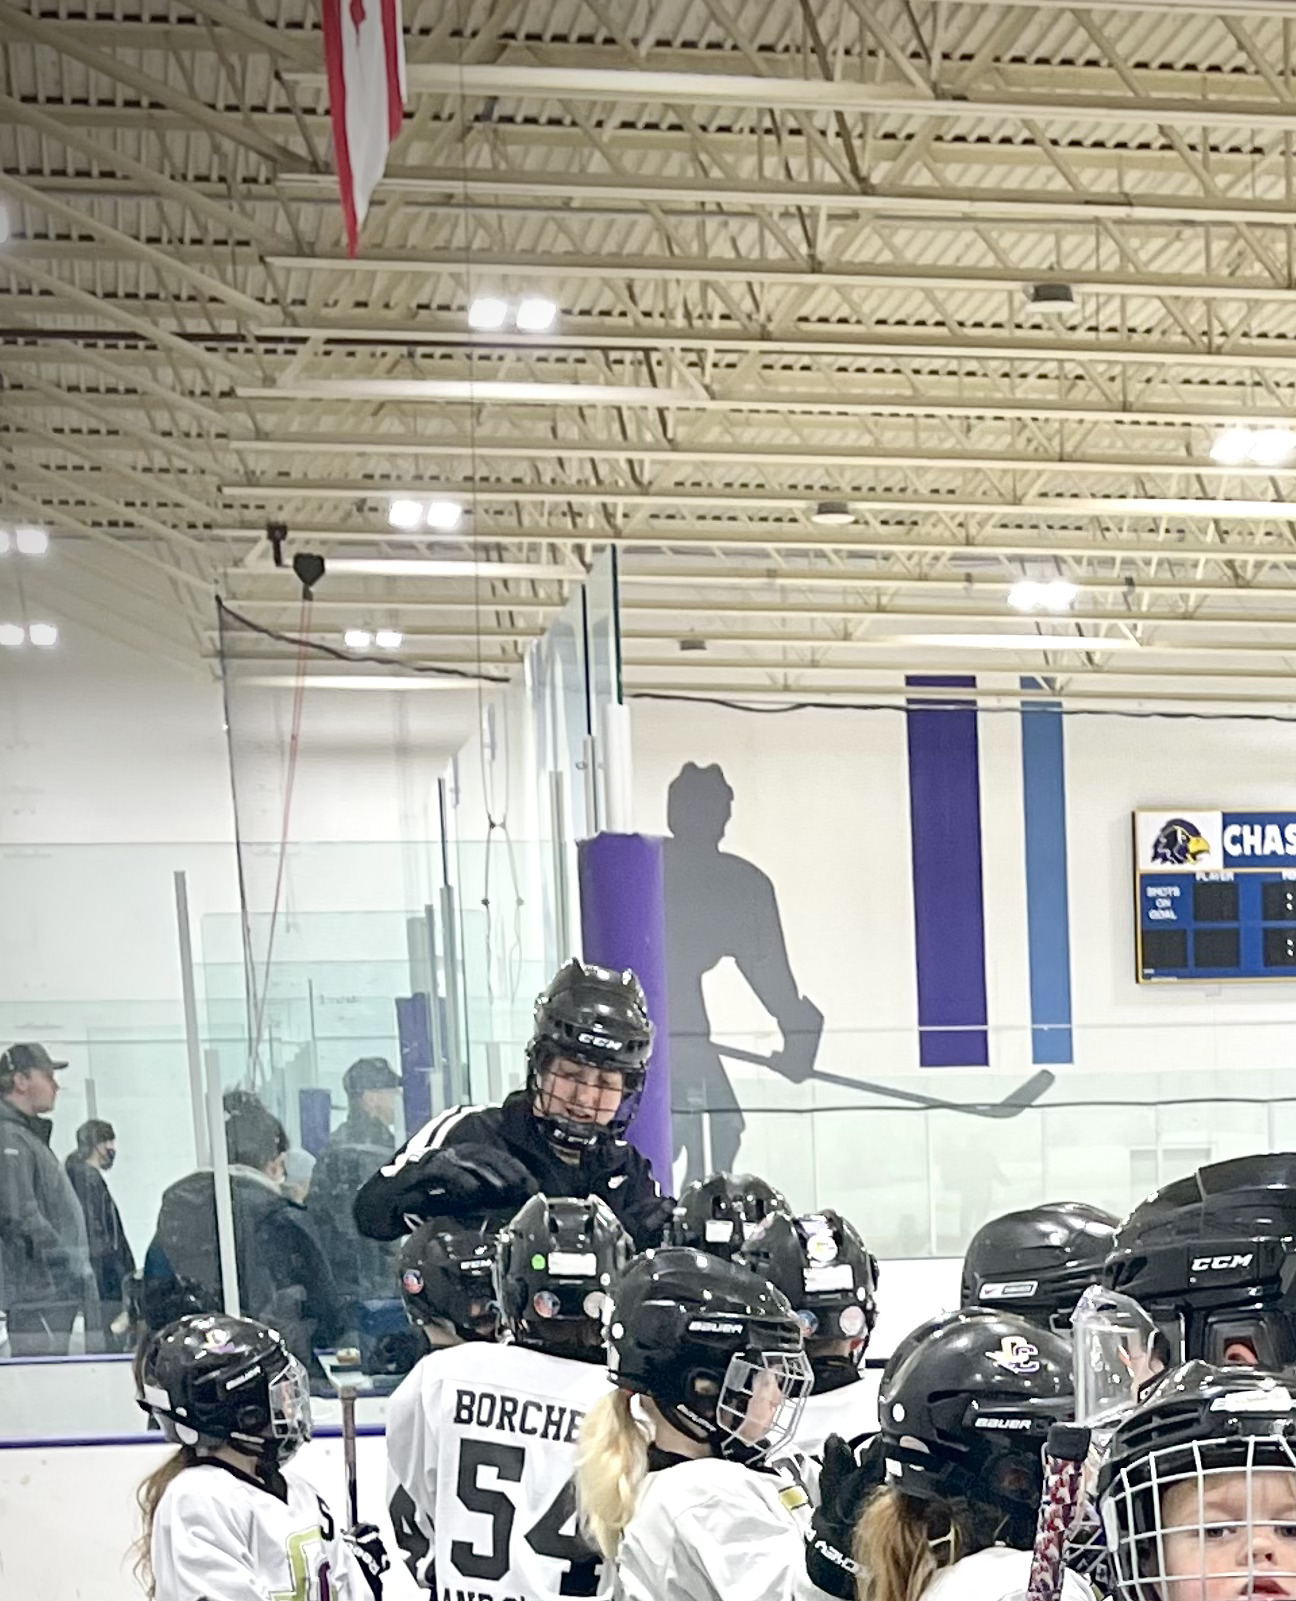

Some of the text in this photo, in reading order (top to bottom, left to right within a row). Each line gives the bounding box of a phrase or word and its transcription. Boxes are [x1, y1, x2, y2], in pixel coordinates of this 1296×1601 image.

[1191, 1253, 1254, 1271] CCM
[975, 1418, 1032, 1430] BAUER
[450, 1437, 606, 1598] 54
